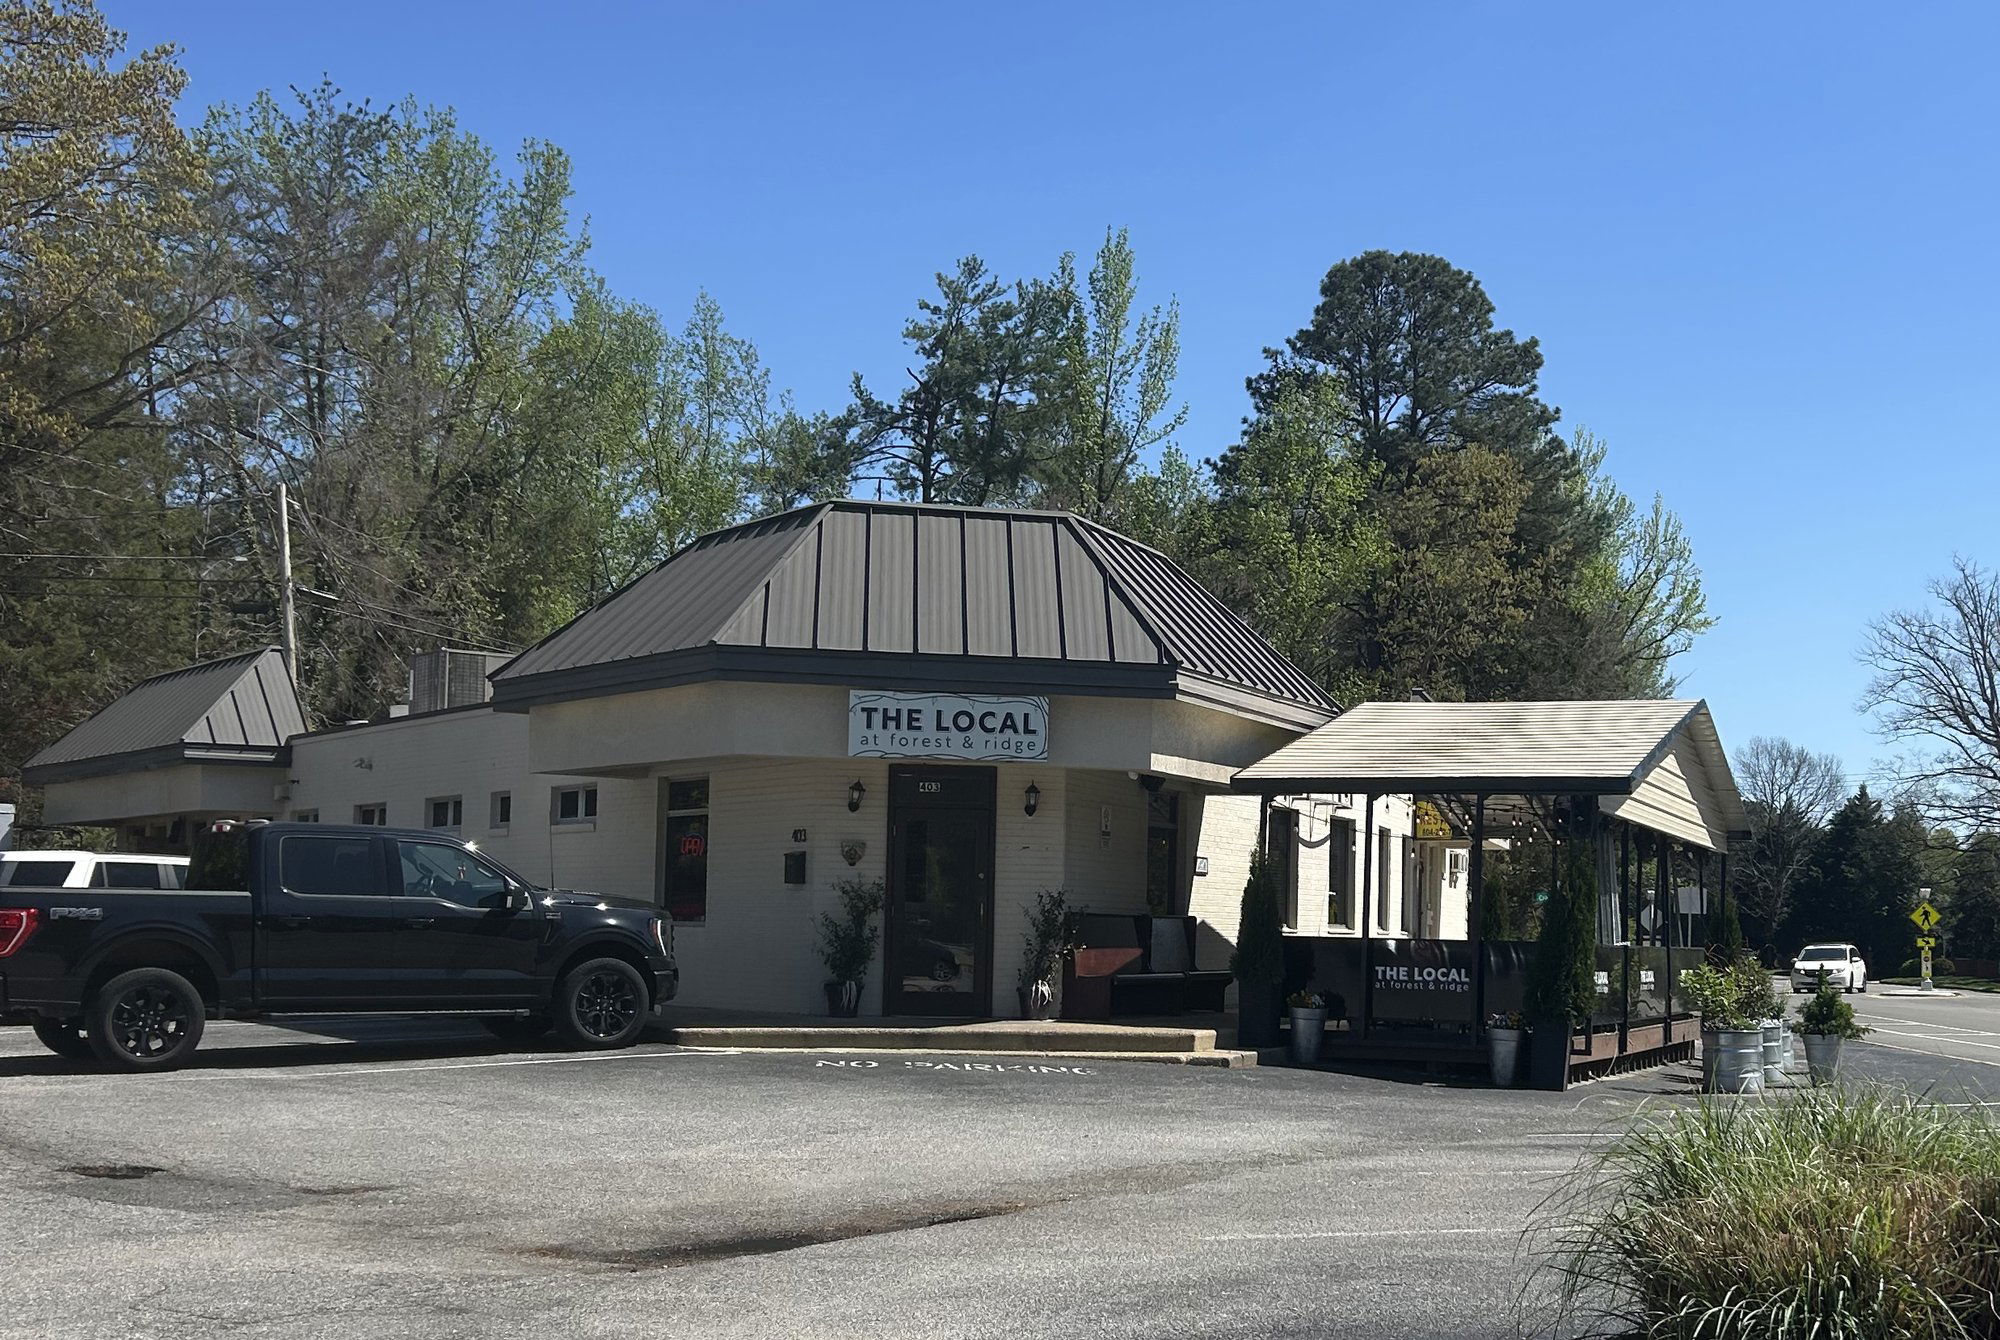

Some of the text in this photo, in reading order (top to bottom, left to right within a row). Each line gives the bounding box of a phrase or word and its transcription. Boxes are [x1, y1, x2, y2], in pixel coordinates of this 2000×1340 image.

[860, 706, 1040, 736] THE LOCAL
[860, 733, 1036, 754] at forest & ridge
[920, 782, 940, 792] 403
[1375, 966, 1470, 983] THE LOCAL
[1375, 981, 1469, 992] at forest & ridge
[815, 1060, 1098, 1076] NO PARKING
